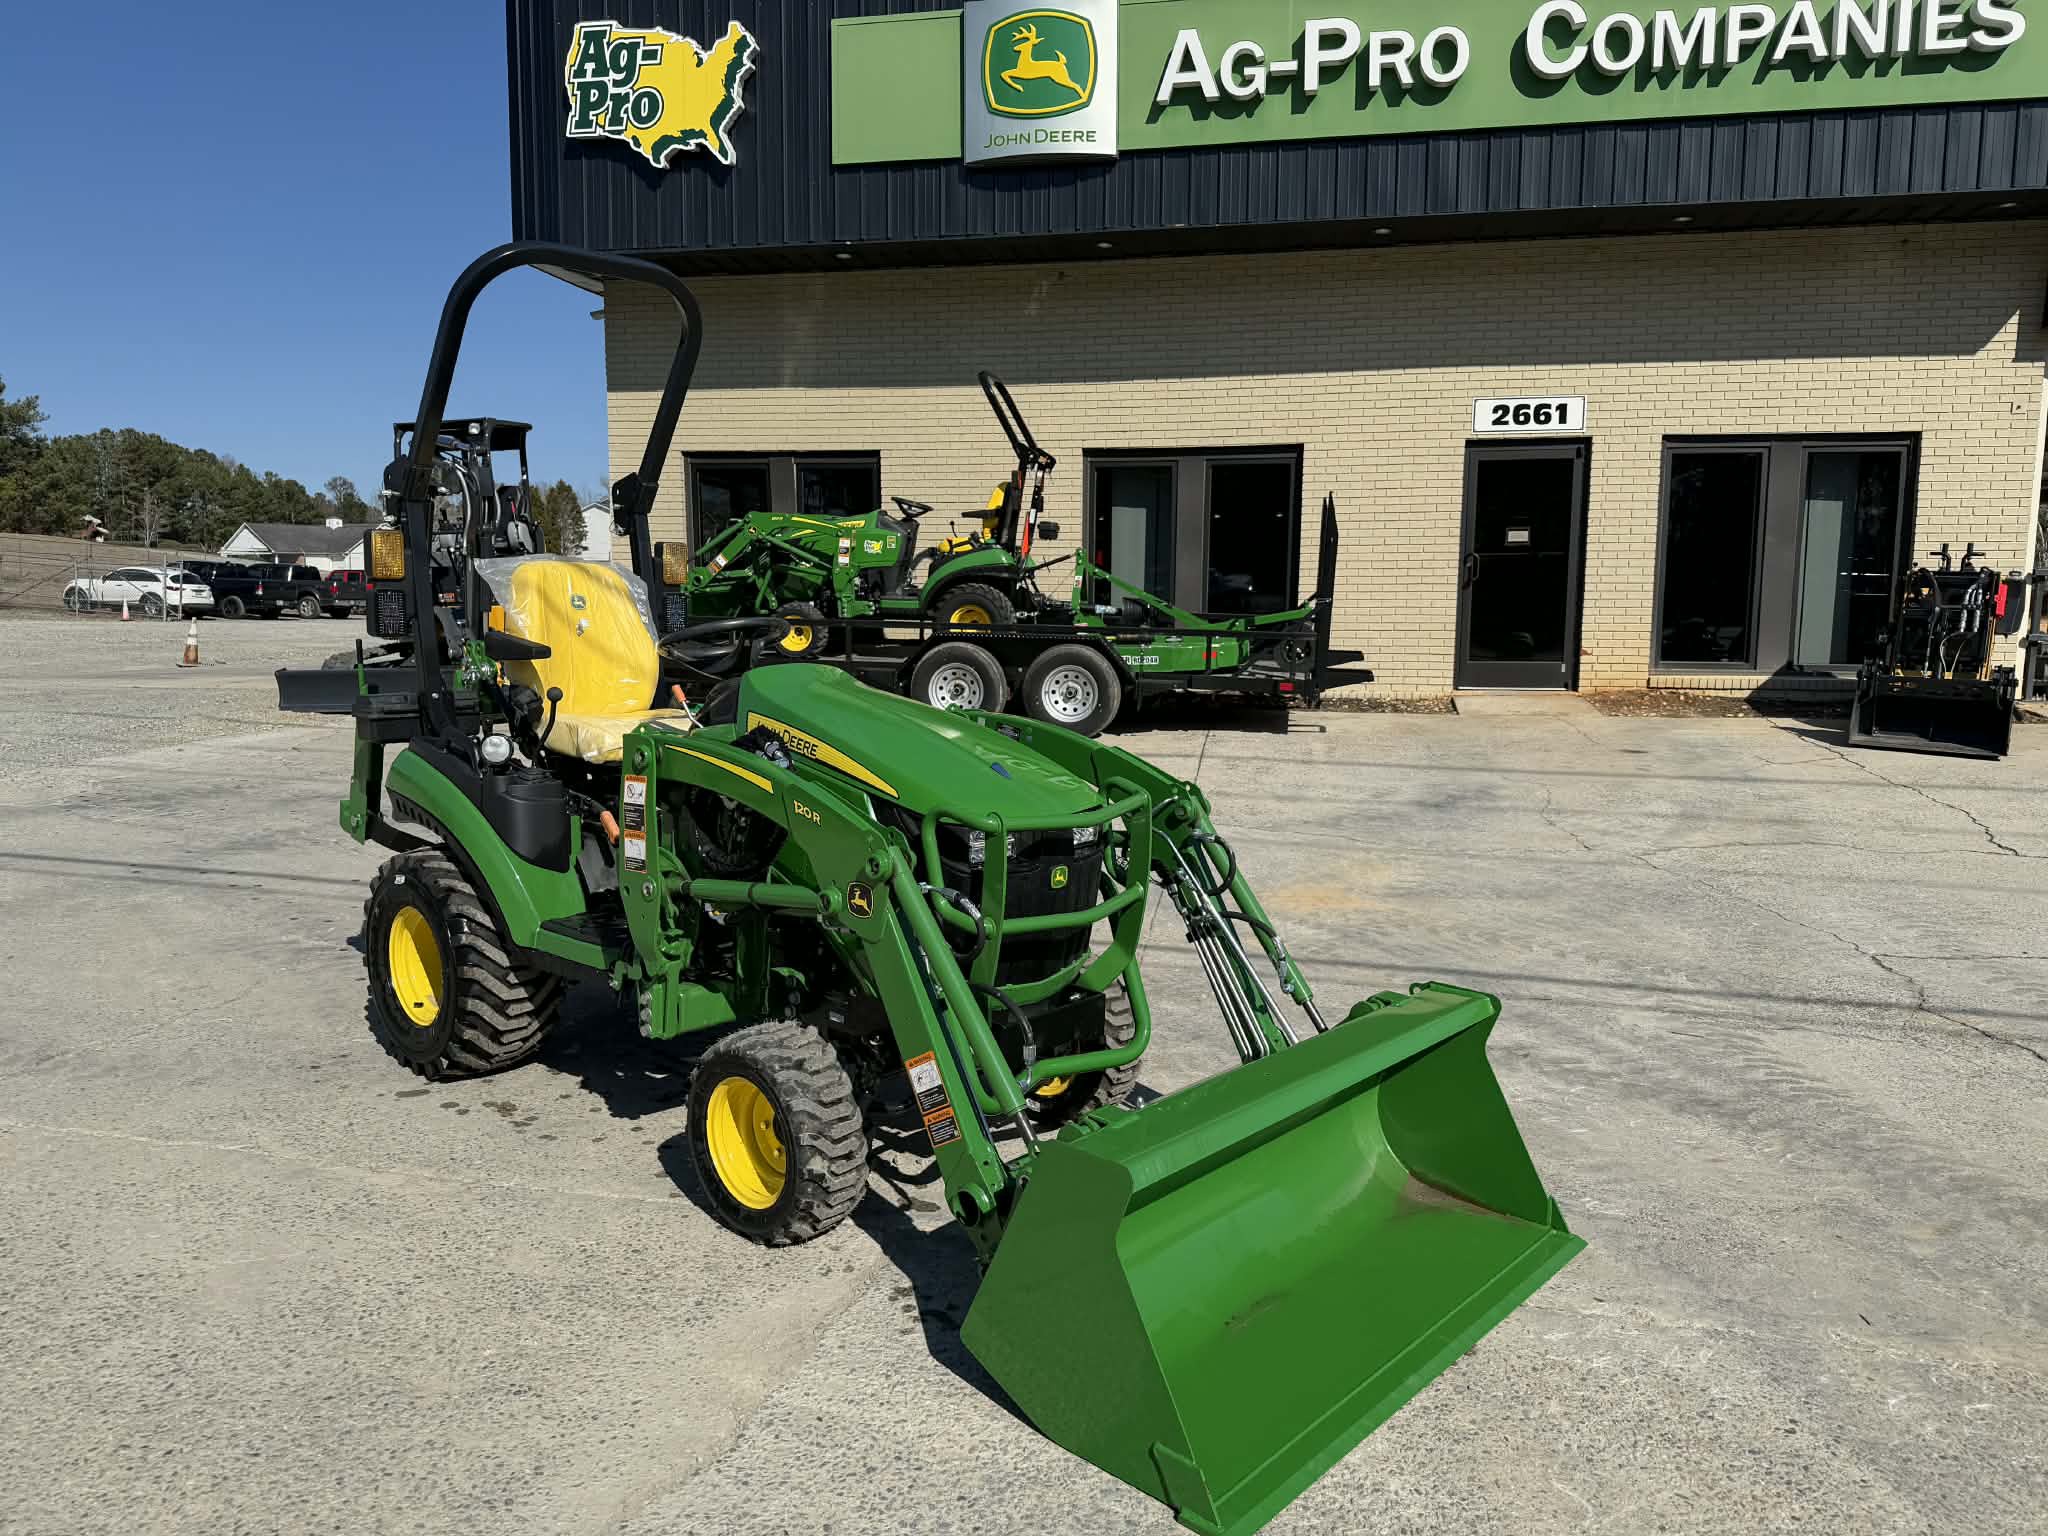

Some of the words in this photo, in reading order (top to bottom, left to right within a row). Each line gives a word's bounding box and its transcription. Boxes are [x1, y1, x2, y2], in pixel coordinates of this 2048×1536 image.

[571, 27, 662, 90] Ag-
[1155, 17, 1470, 105] AG-PRO
[1526, 0, 2026, 79] COMPANIES
[572, 80, 662, 130] Pro
[984, 132, 1031, 148] JOHN
[1034, 128, 1097, 144] DEERE
[1492, 403, 1567, 426] 2661
[783, 729, 818, 756] DEERE
